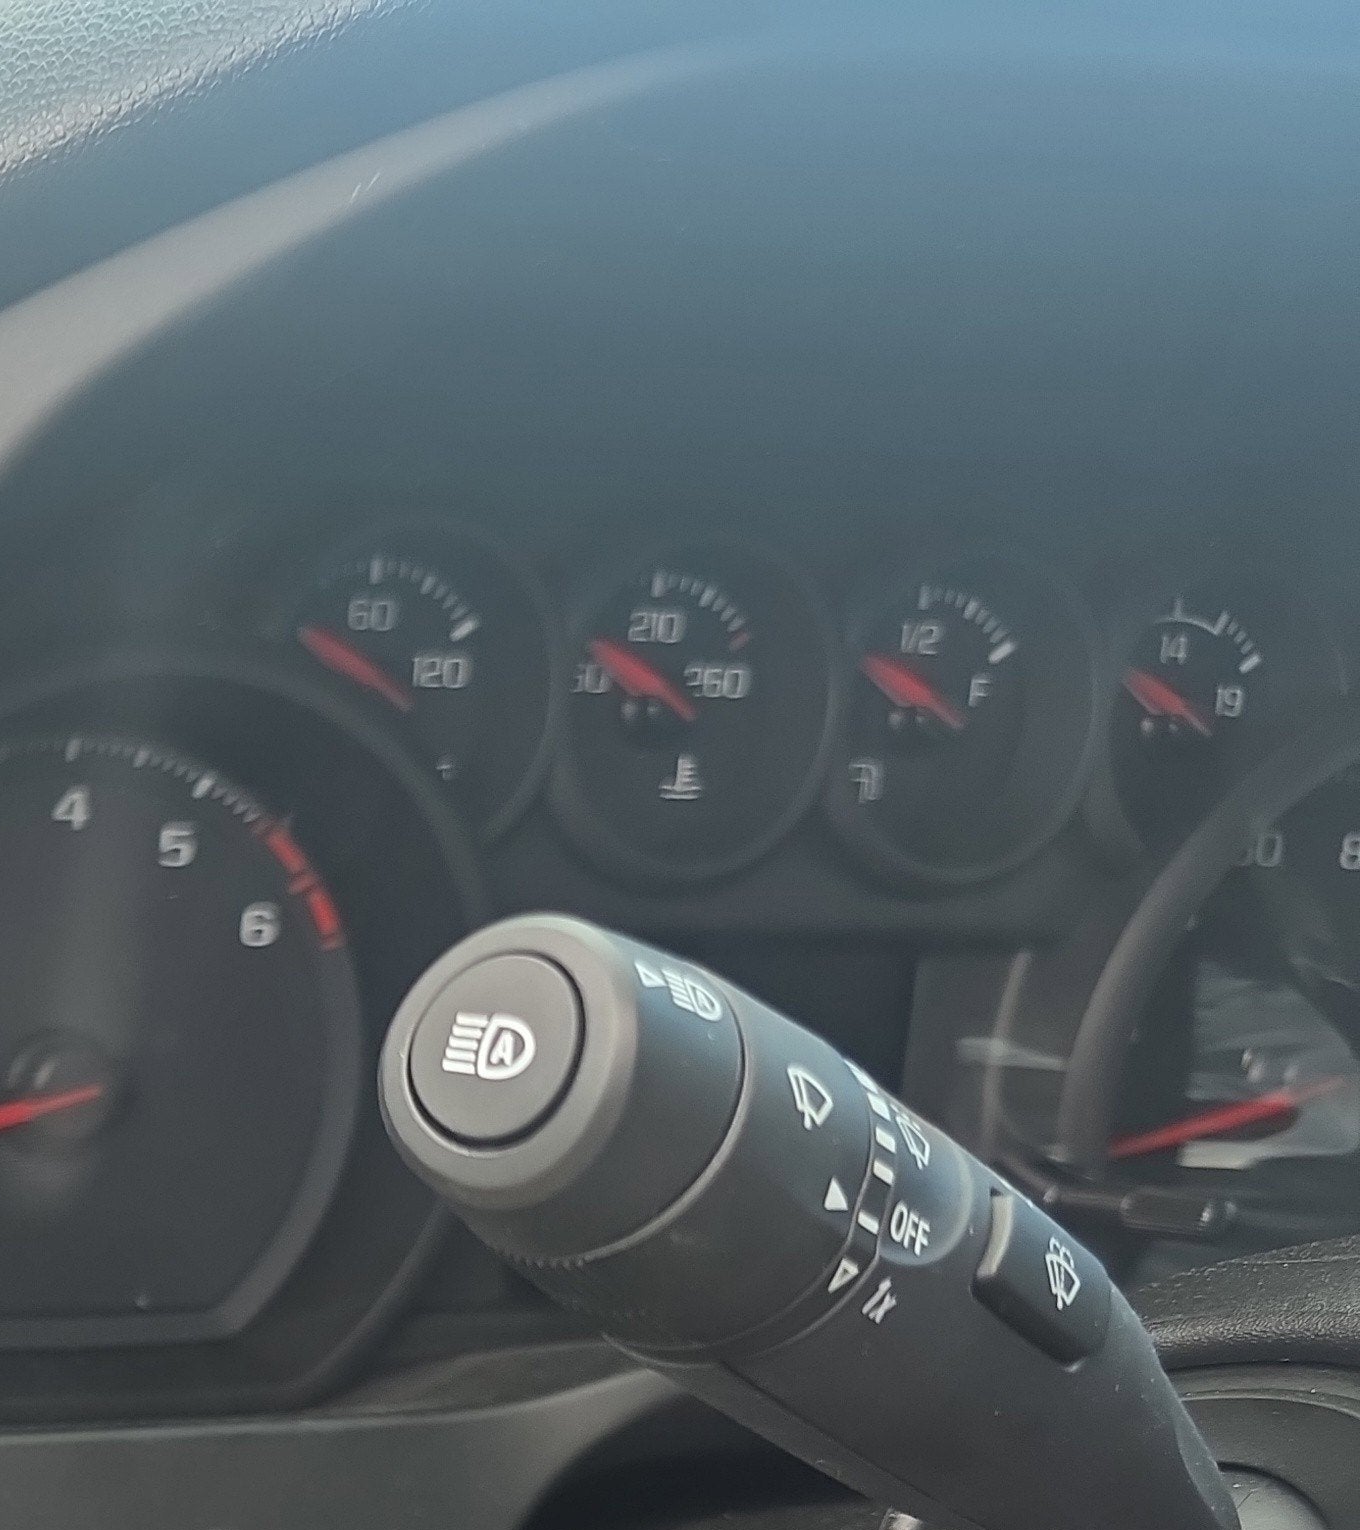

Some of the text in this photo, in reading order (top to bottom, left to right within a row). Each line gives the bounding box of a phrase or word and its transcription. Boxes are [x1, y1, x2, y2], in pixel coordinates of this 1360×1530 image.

[347, 600, 397, 632] 60
[627, 610, 682, 644] 210
[900, 621, 940, 655] 1/2
[1160, 634, 1188, 664] 14
[412, 656, 470, 689] 120
[969, 675, 991, 708] F
[1216, 685, 1243, 718] 19
[51, 786, 91, 830] 4
[158, 823, 197, 867] 5
[239, 902, 279, 947] 6
[889, 1201, 931, 1256] OFF
